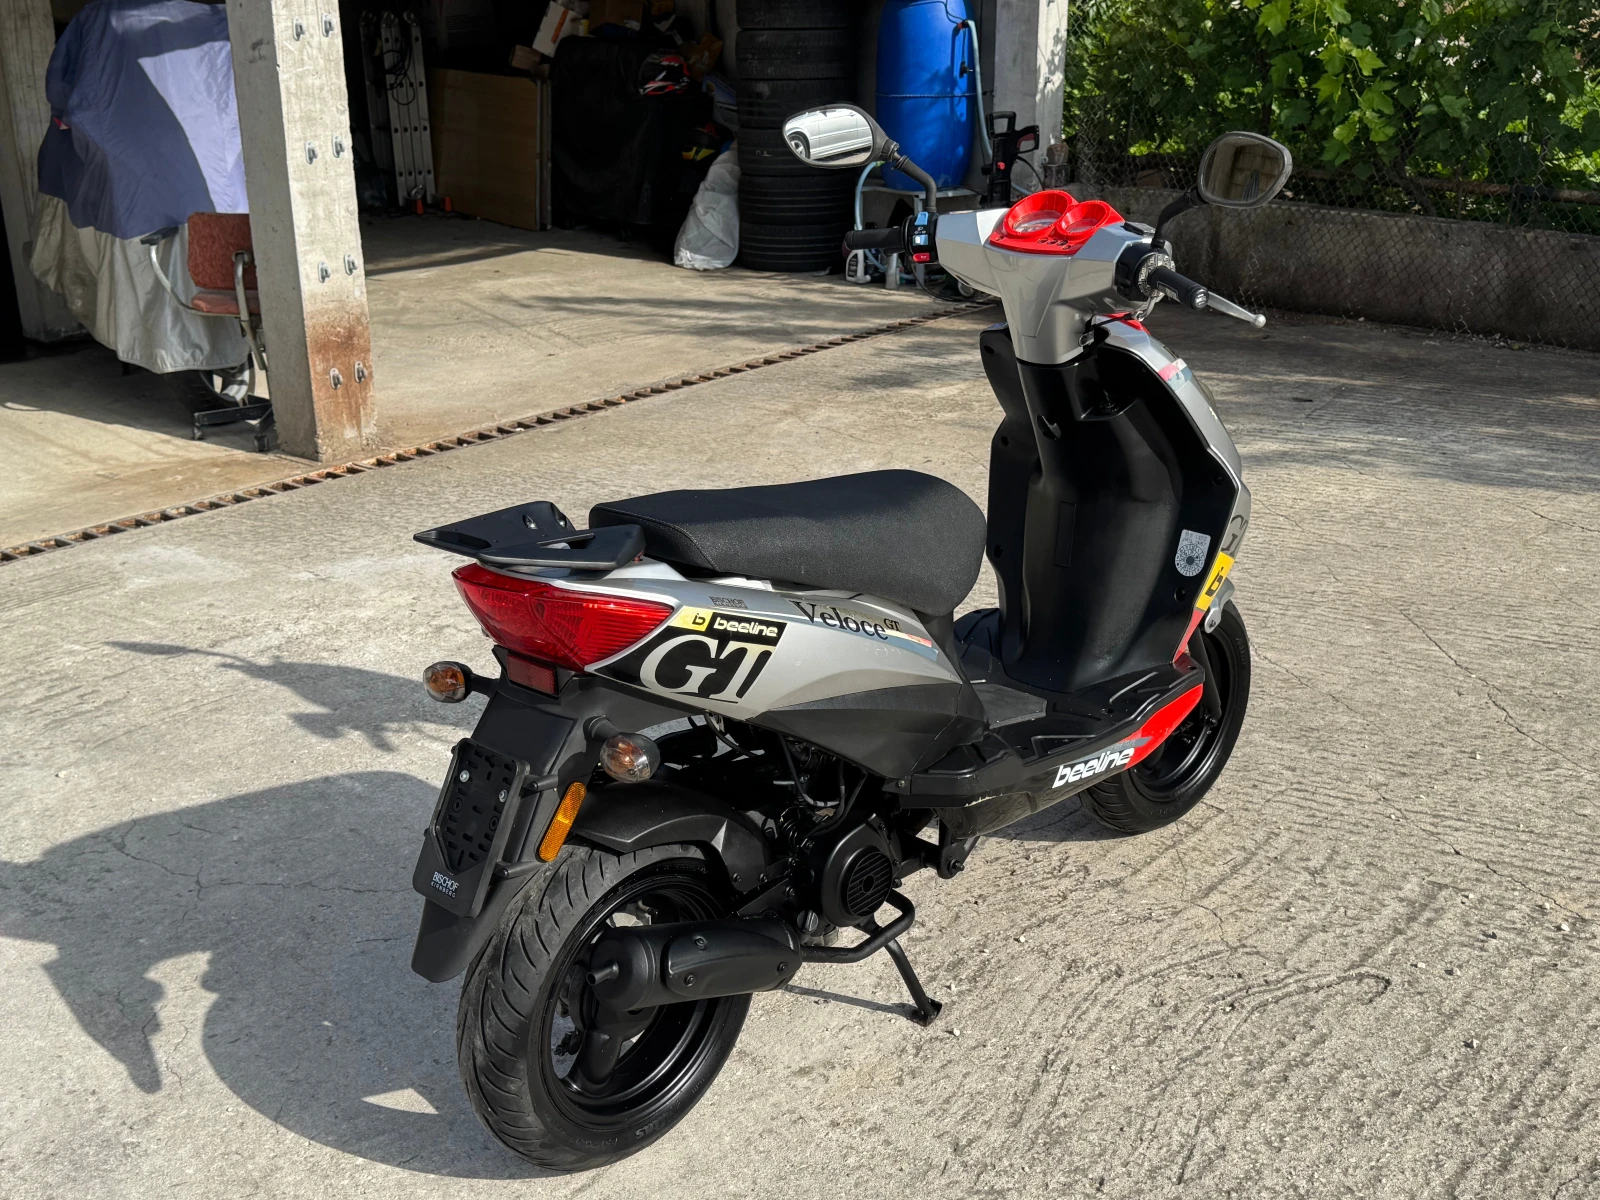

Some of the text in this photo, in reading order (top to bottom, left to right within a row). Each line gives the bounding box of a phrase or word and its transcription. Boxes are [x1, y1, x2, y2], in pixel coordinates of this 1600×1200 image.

[713, 617, 778, 637] beeline
[789, 600, 901, 640] Veloce GT
[639, 634, 777, 700] GT
[1051, 747, 1135, 789] beeline
[432, 871, 460, 892] BISCHOF
